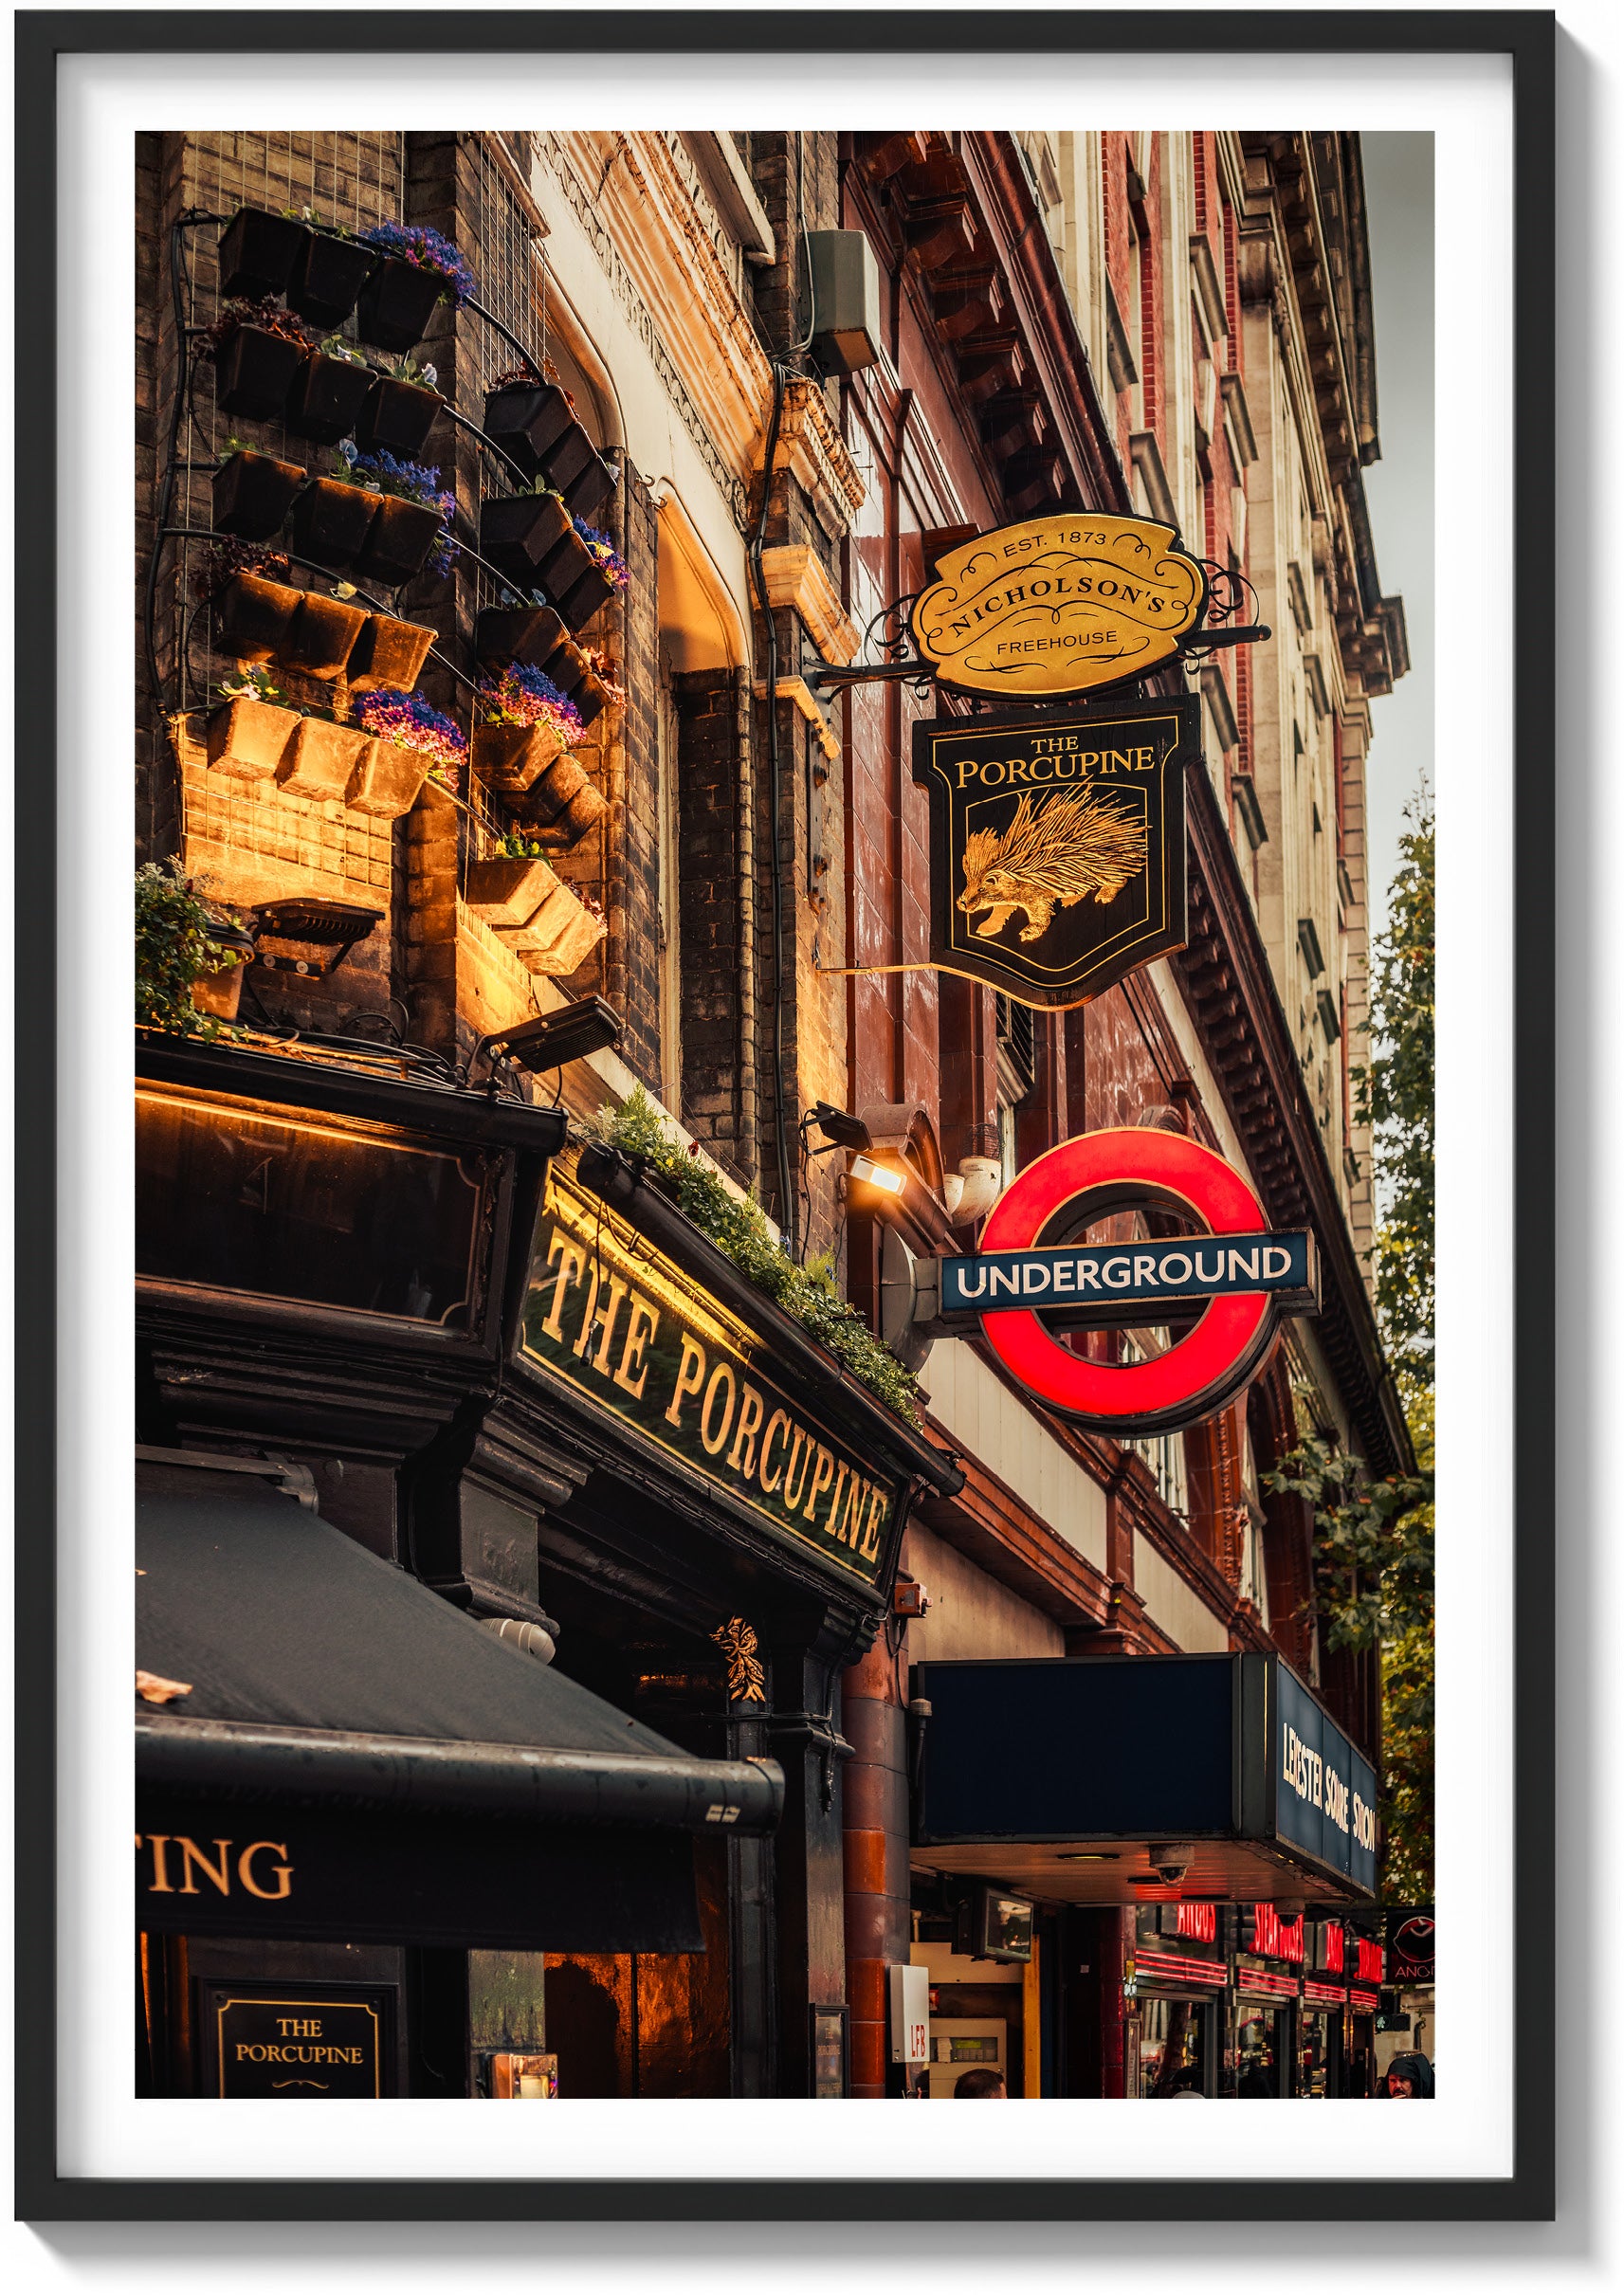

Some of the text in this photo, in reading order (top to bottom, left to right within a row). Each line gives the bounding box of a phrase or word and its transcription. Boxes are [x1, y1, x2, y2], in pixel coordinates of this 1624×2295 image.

[1003, 530, 1106, 557] EST. 1873
[949, 576, 1165, 638] NICHOLSON'S
[996, 629, 1118, 655] FREEHOUSE
[1031, 735, 1079, 755] THE
[955, 747, 1155, 789] PORCUPINE
[958, 1247, 1292, 1298] UNDERGROUND
[541, 1226, 886, 1563] THE PORCUPINE
[1283, 1721, 1376, 1853] LEIESTER SQRE STON
[135, 1833, 295, 1900] ING
[276, 2018, 323, 2037] THE
[910, 2024, 926, 2058] LFB
[236, 2045, 364, 2065] PORCUPINE
